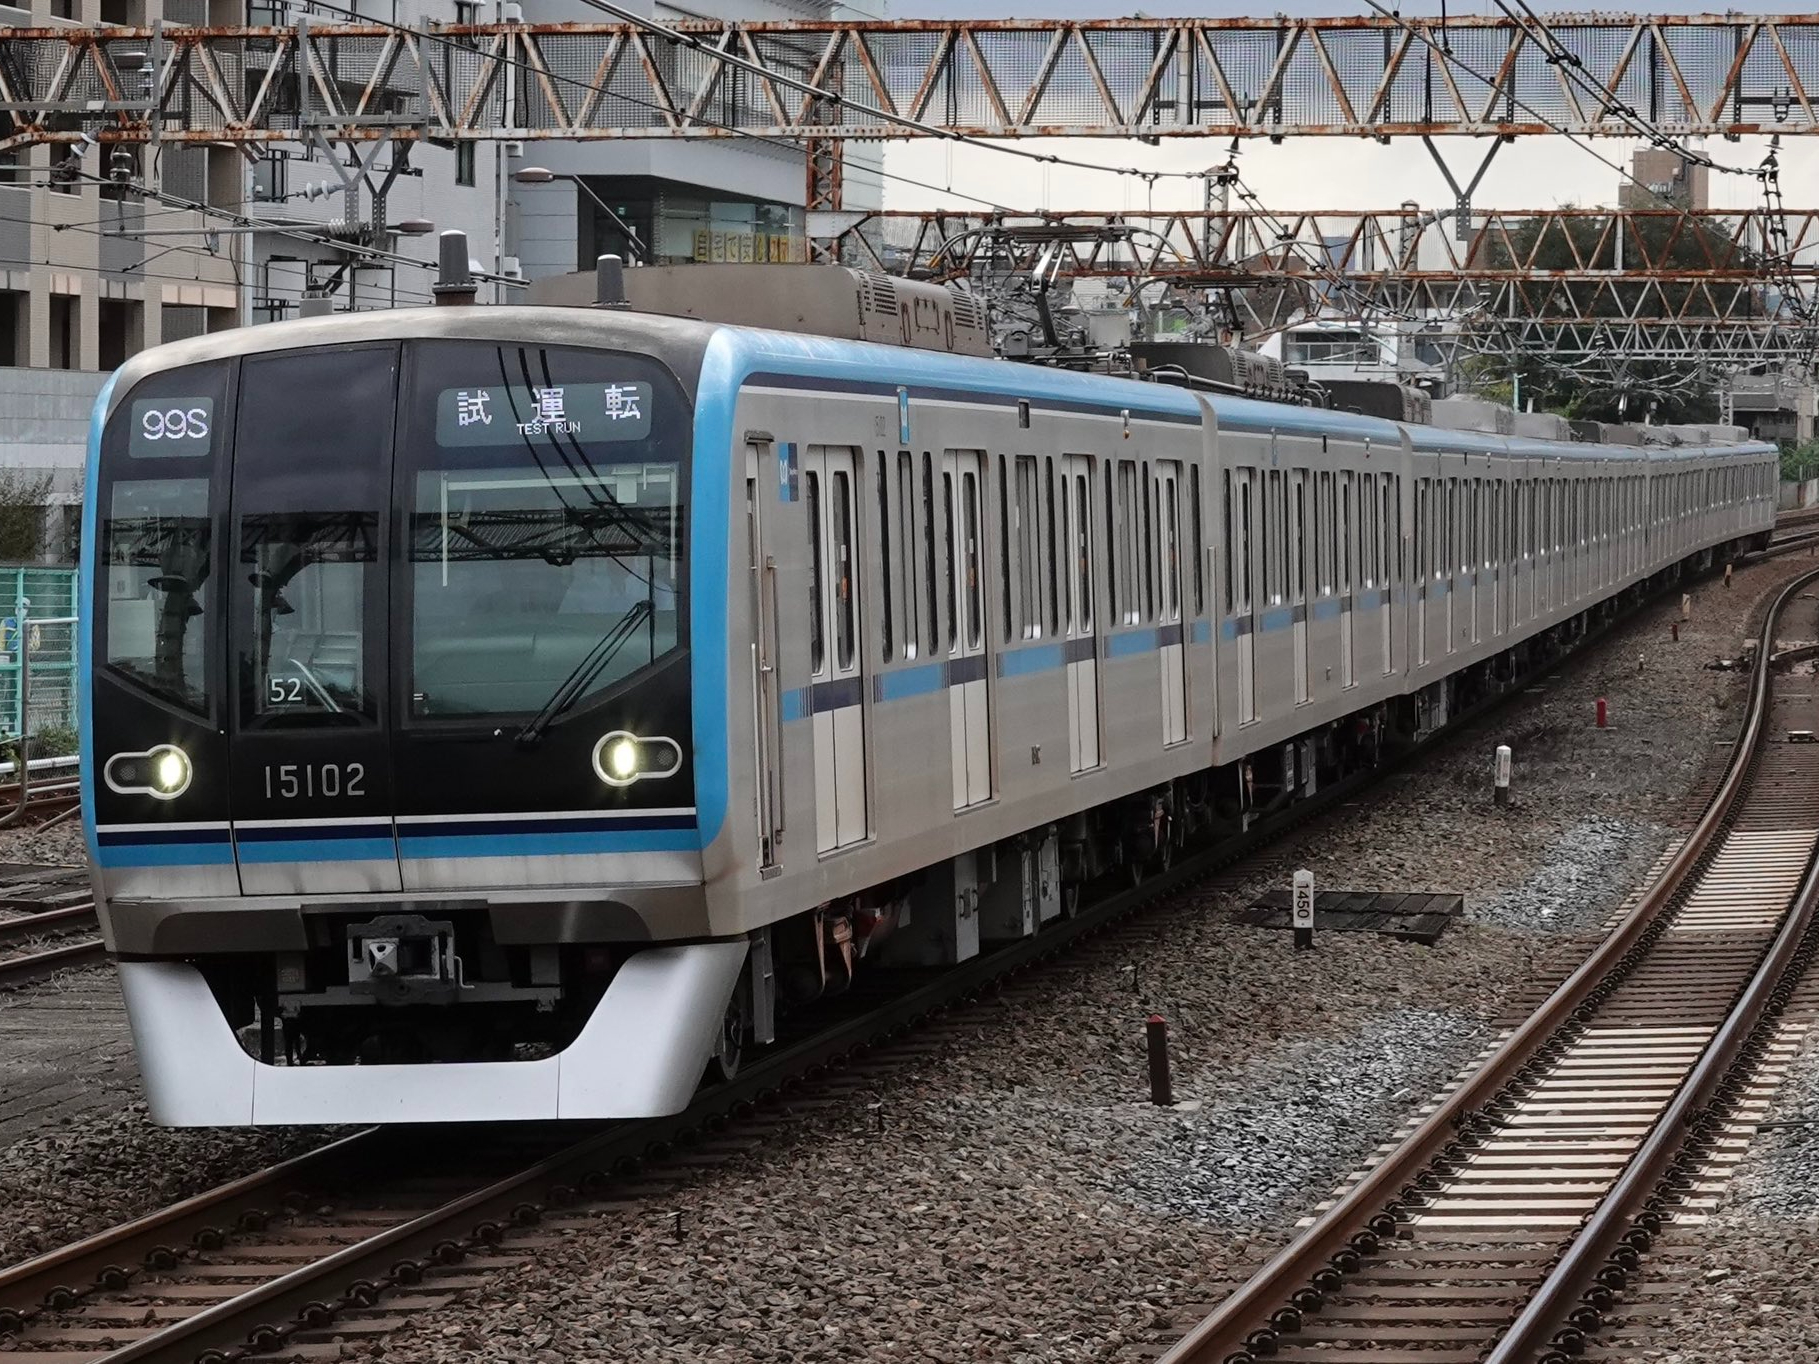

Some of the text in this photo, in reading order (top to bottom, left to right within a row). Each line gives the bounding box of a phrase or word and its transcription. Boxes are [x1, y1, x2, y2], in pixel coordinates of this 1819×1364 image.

[457, 384, 641, 427] 試運転
[142, 408, 209, 440] 99S
[516, 421, 581, 435] TEST RUN
[270, 678, 302, 702] 52
[265, 762, 365, 798] 15102
[1296, 882, 1310, 919] 1450
